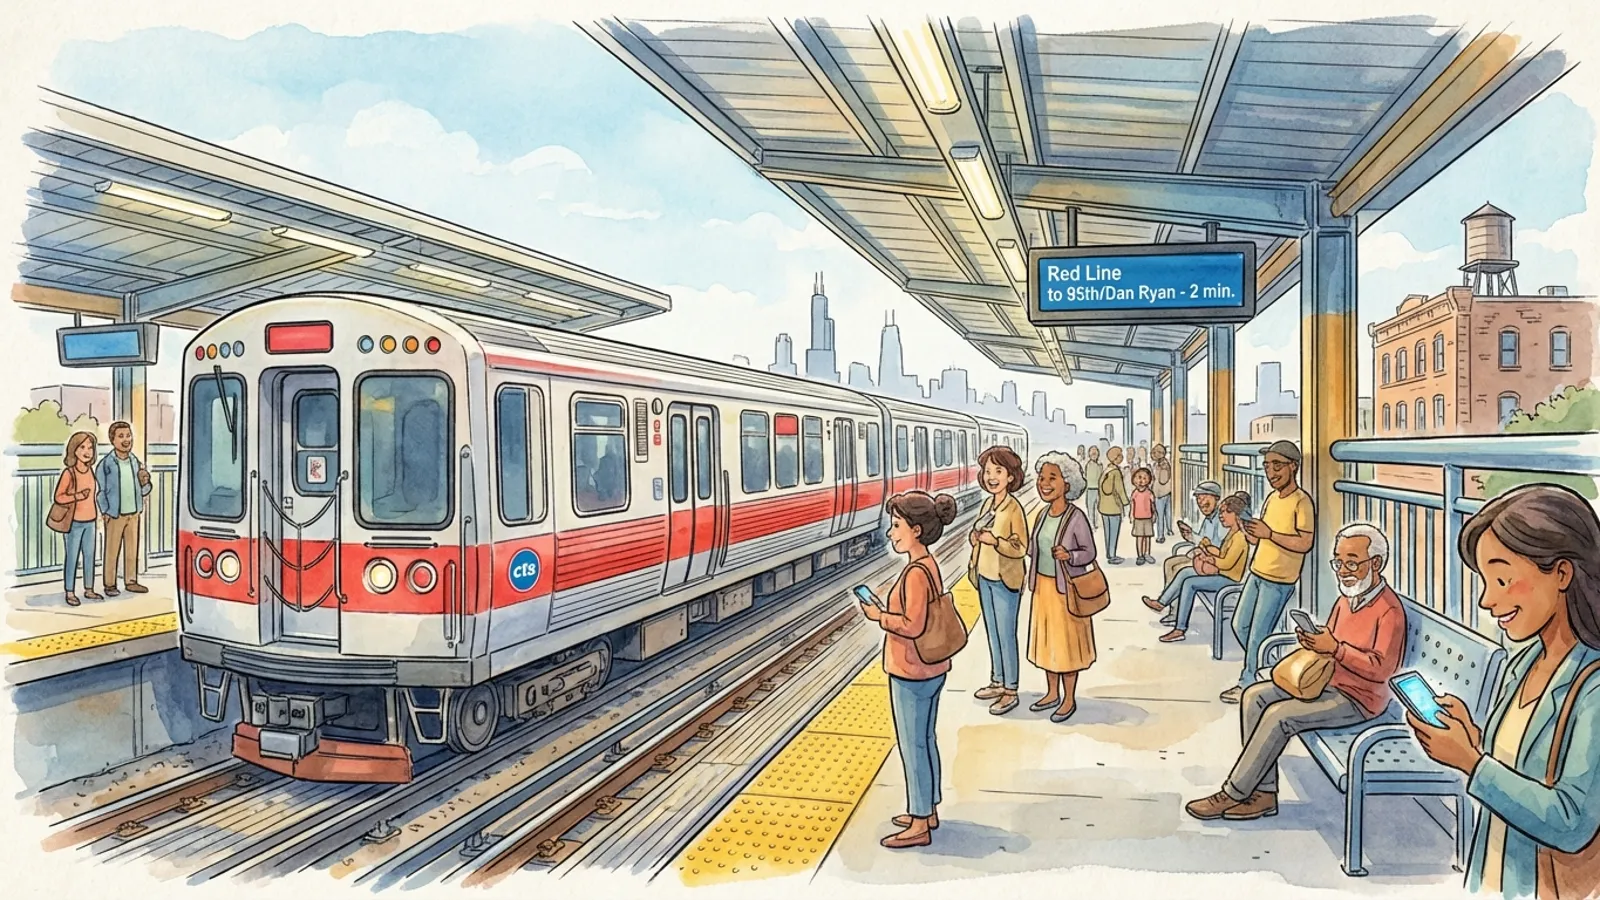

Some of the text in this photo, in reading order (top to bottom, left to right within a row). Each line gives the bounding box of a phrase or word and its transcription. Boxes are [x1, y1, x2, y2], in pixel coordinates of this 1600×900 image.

[1047, 264, 1122, 282] Red Line
[1047, 287, 1063, 302] to
[1138, 284, 1176, 304] Ryan
[1189, 283, 1199, 299] 2
[1203, 283, 1235, 298] min.
